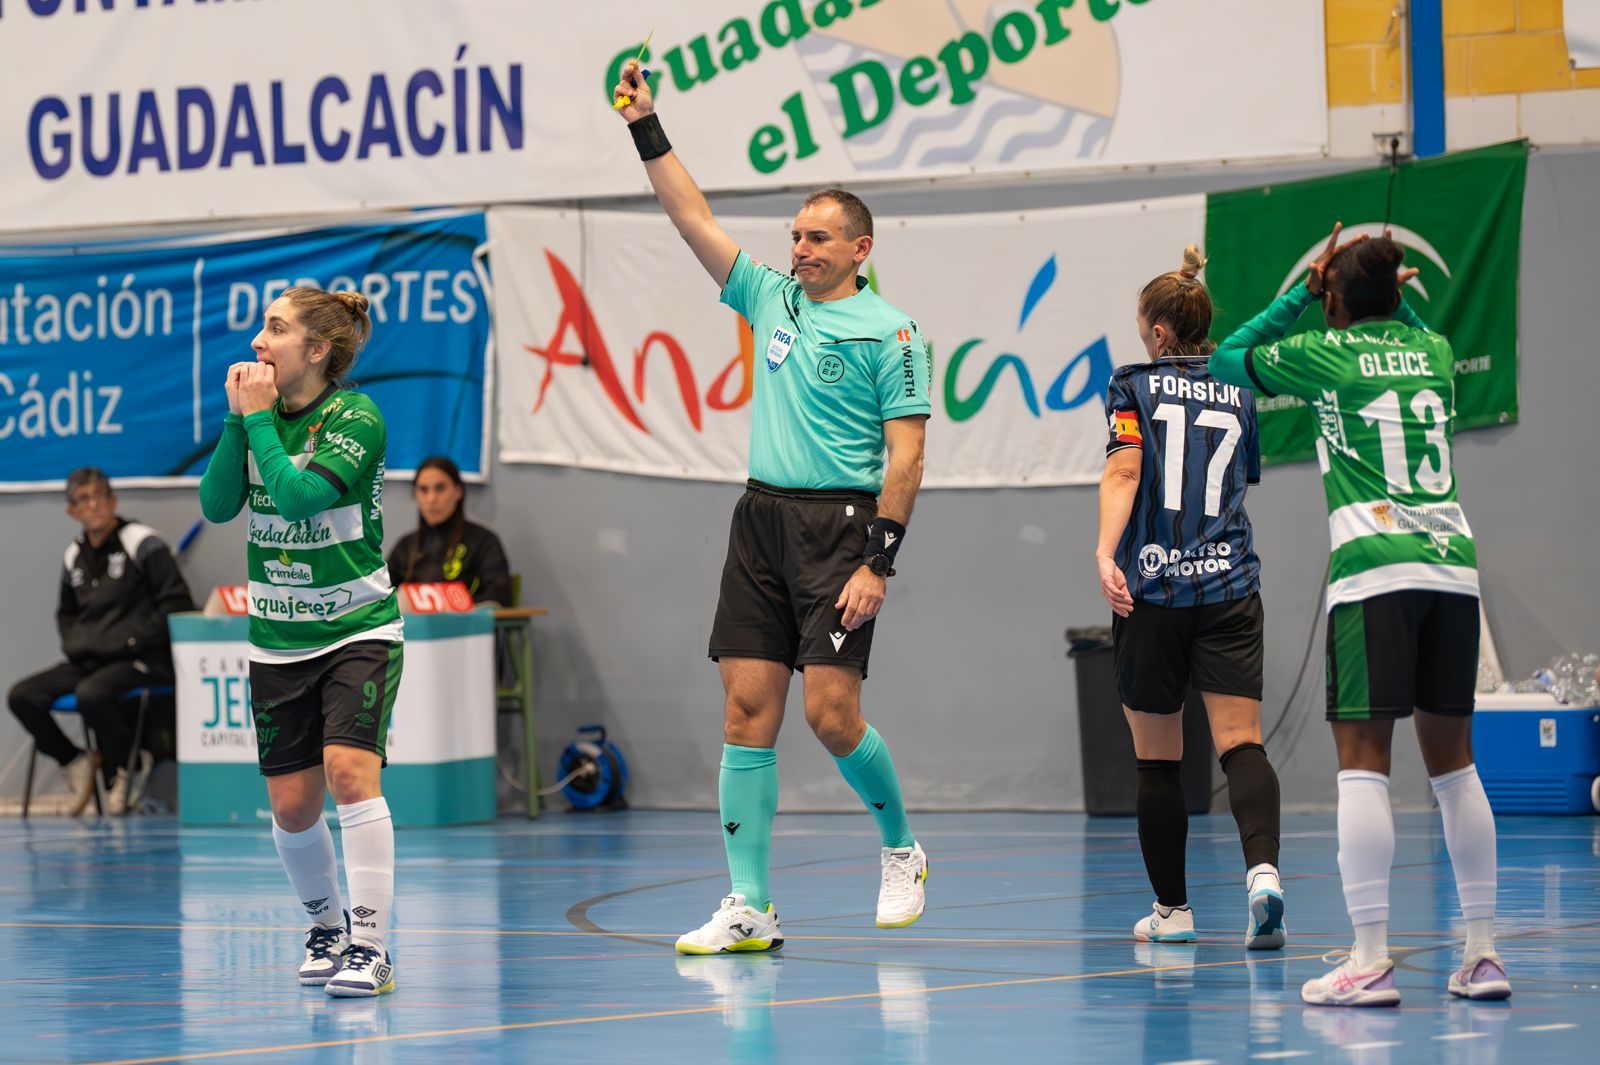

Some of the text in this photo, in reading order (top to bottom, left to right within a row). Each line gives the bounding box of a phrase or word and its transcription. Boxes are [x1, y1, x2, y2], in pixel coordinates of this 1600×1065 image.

[604, 0, 886, 110] Guada
[27, 44, 524, 180] GUADALCACÍN
[748, 0, 1149, 174] el Depor
[773, 329, 792, 346] FIFA
[1359, 351, 1434, 378] GLEICE
[901, 344, 916, 398] WÜRTH
[1148, 374, 1241, 408] FORSIJK
[1151, 402, 1243, 518] 17
[1357, 388, 1452, 494] 13
[1165, 558, 1232, 577] MOTOR
[362, 680, 377, 709] 9
